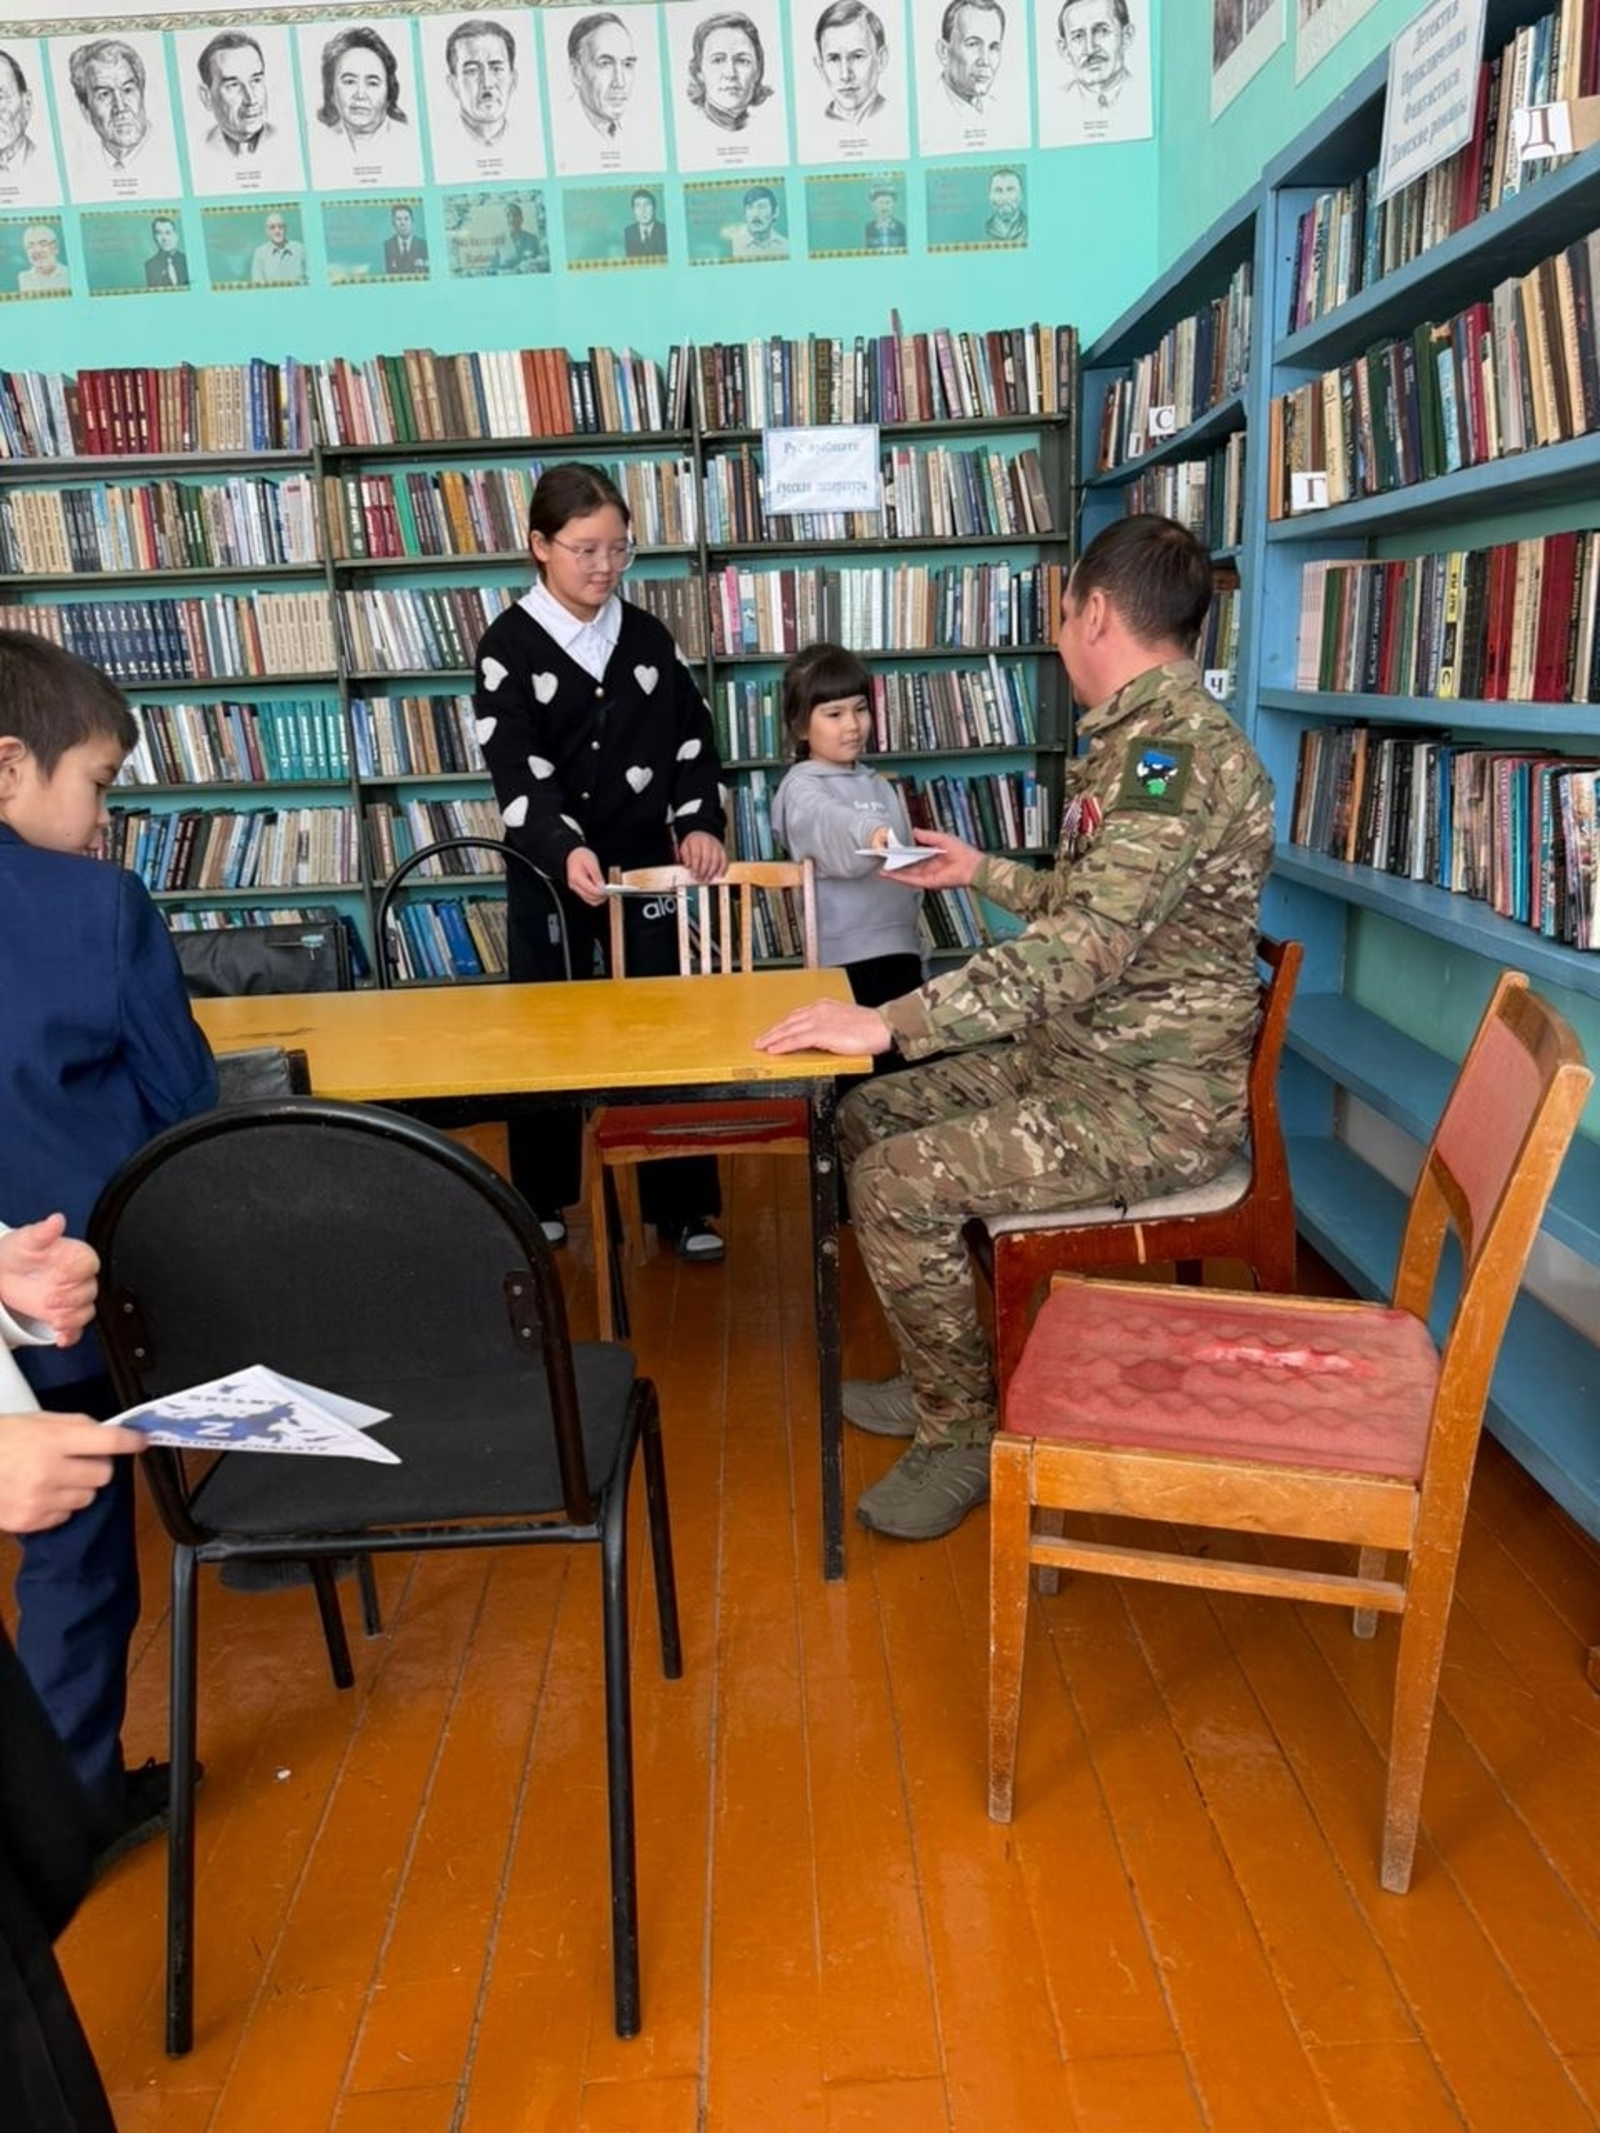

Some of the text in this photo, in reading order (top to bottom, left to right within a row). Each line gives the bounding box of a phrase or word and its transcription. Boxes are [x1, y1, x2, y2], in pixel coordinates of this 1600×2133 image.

[1404, 68, 1460, 125] Фантастика
[1520, 107, 1556, 156] Д
[1306, 478, 1327, 503] Г
